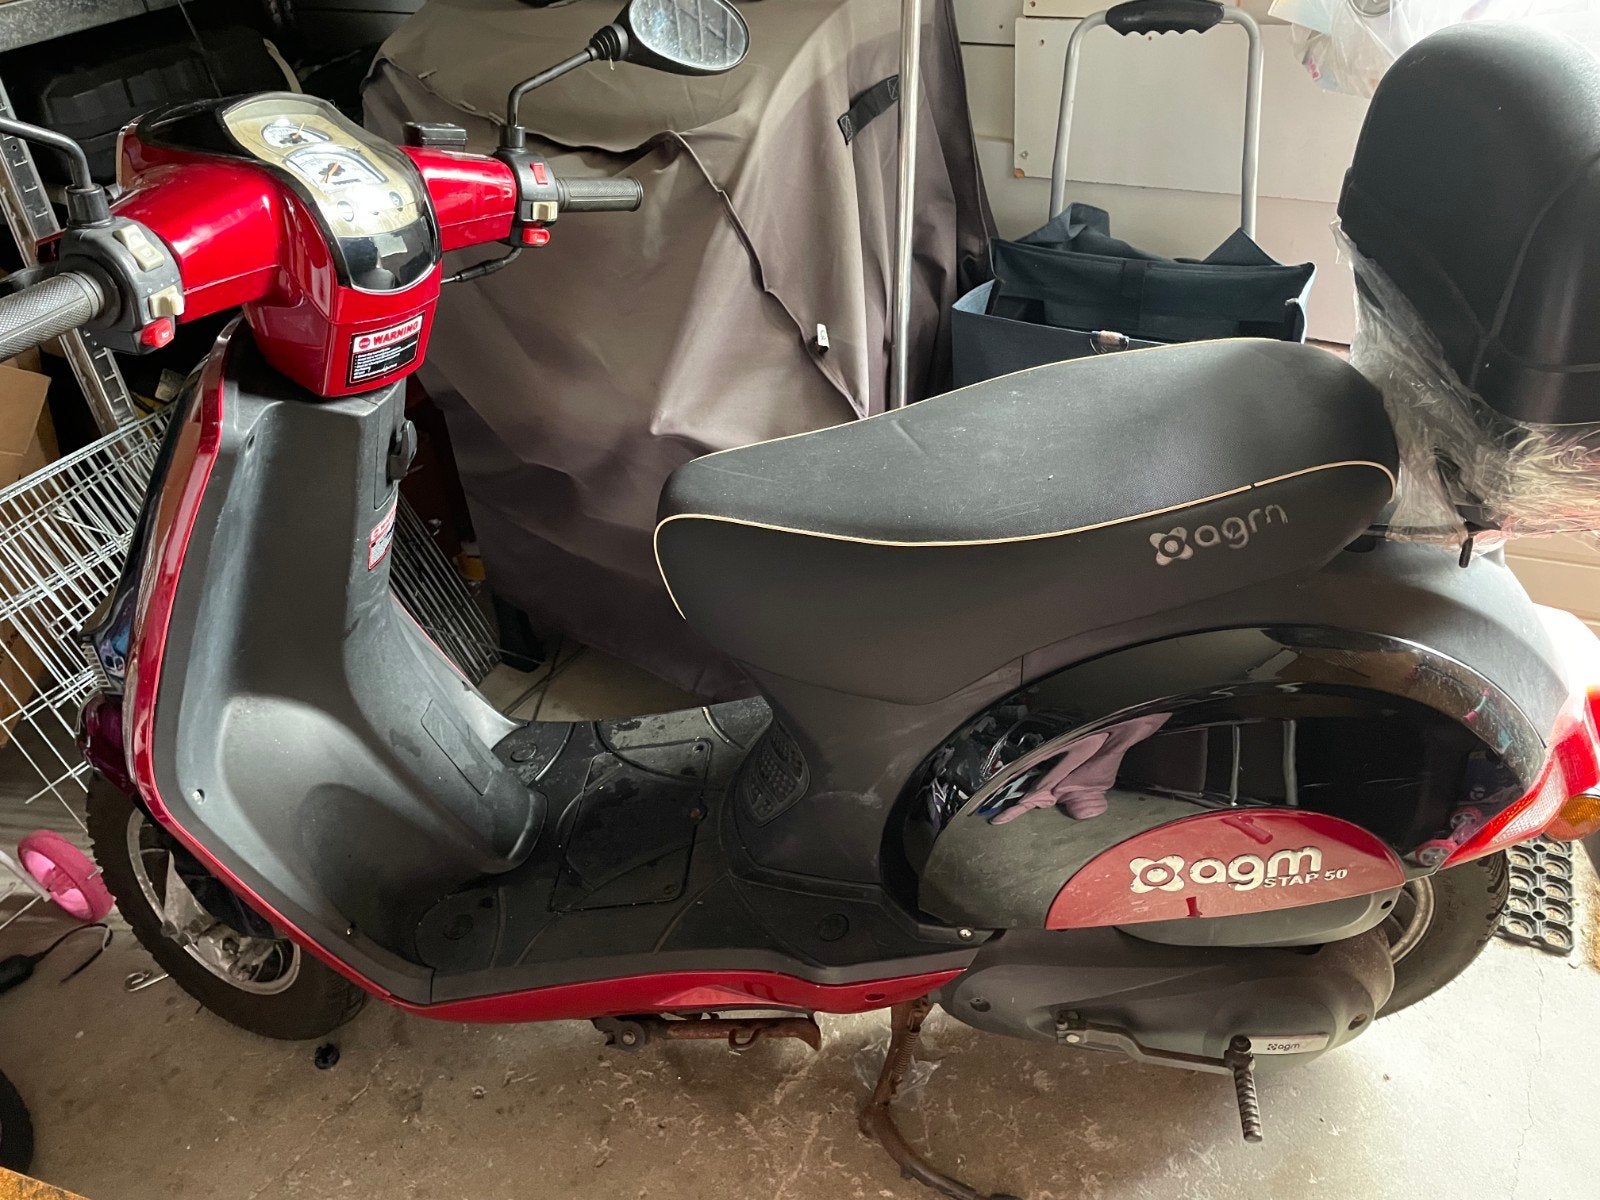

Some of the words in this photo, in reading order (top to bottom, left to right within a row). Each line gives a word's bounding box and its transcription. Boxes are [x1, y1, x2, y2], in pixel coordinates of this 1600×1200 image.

[373, 321, 419, 345] WARNING
[1189, 846, 1322, 891] agm
[1324, 868, 1348, 881] 50
[1277, 1043, 1300, 1051] agm
